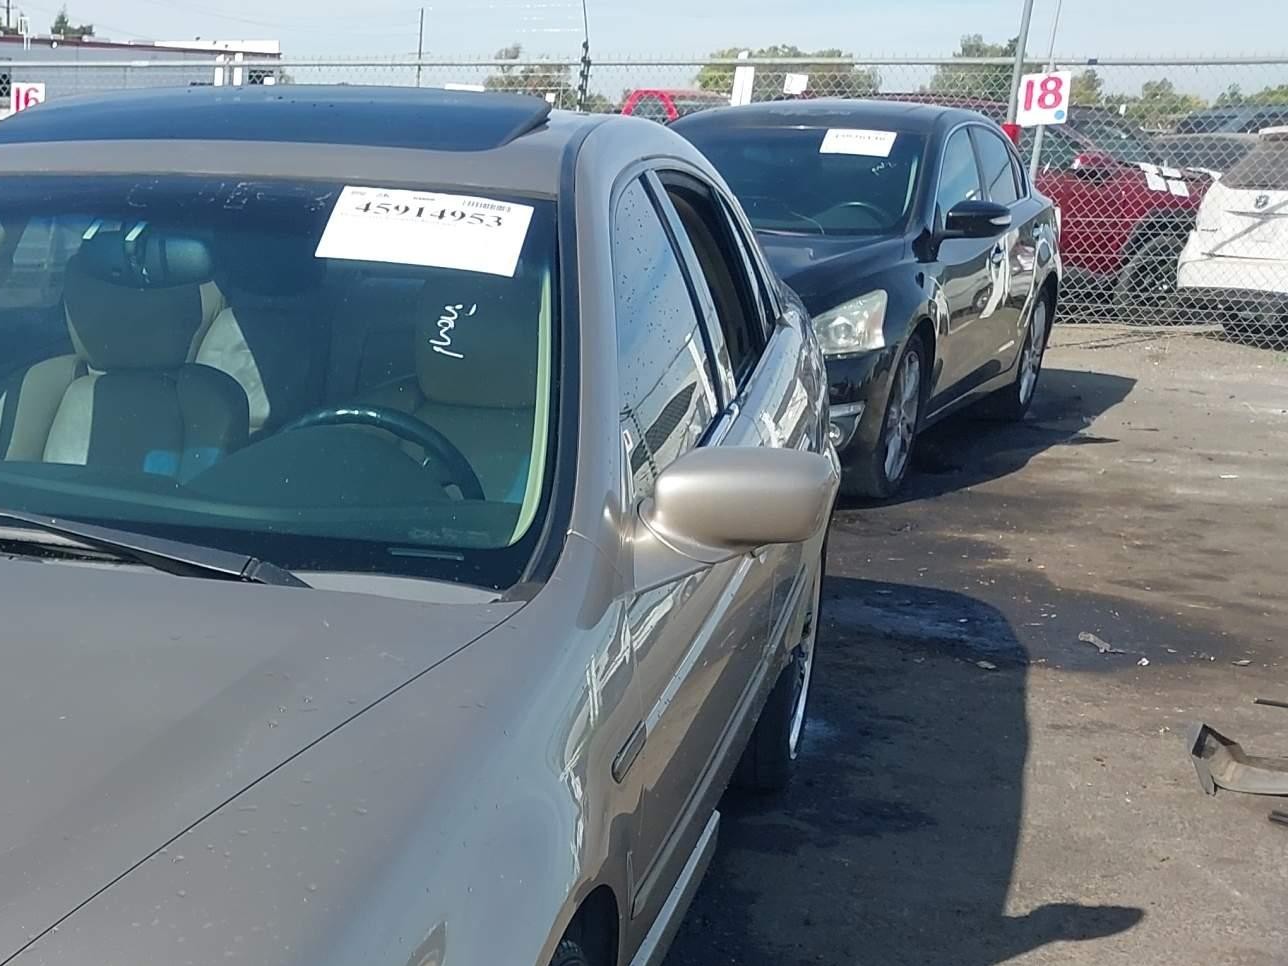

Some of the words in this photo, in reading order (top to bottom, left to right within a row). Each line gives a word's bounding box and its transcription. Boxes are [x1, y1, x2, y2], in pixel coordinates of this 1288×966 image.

[15, 87, 40, 112] 16
[1024, 77, 1063, 111] 18
[354, 200, 503, 229] 45914953
